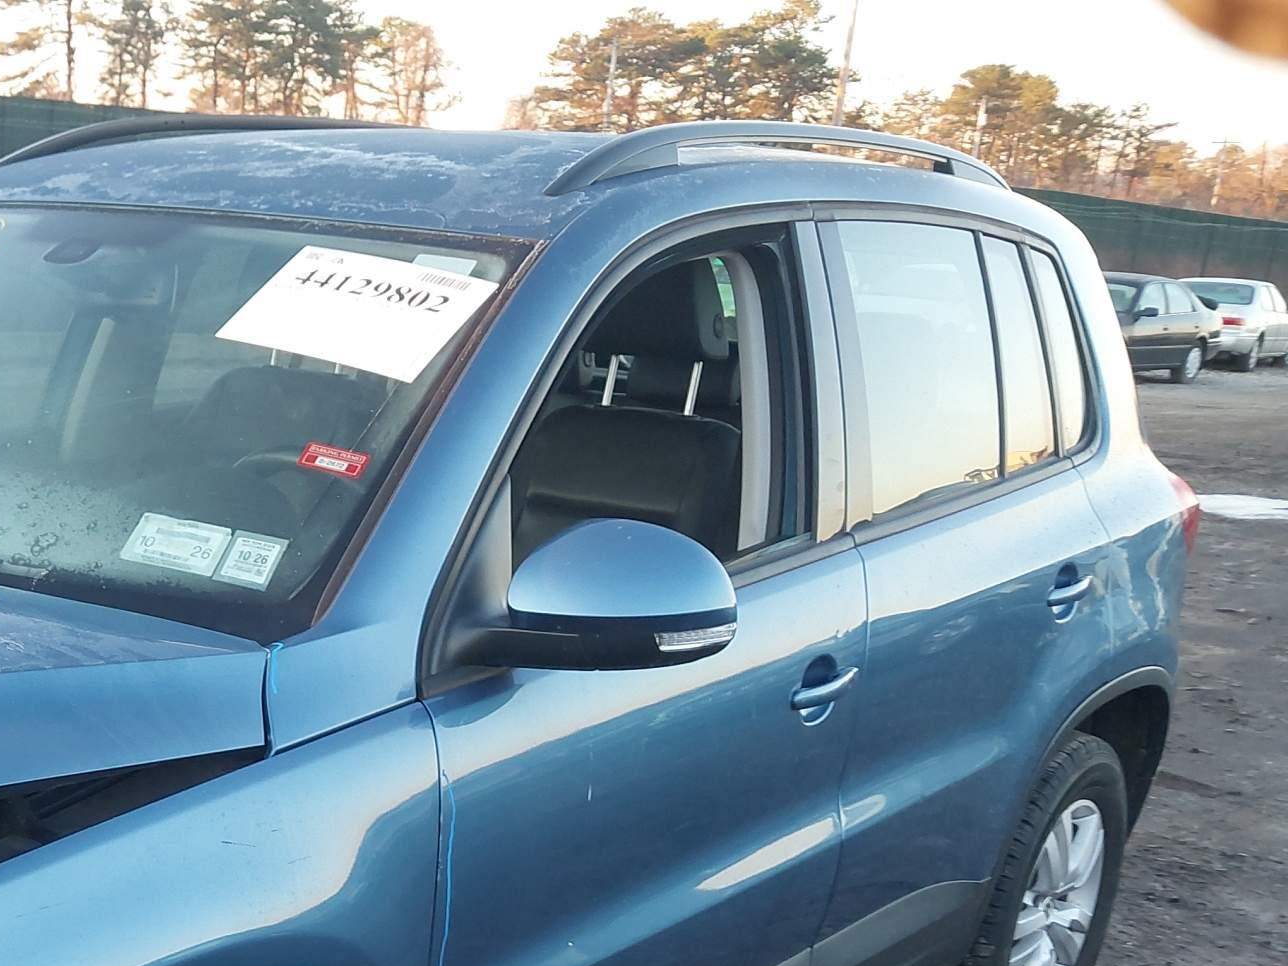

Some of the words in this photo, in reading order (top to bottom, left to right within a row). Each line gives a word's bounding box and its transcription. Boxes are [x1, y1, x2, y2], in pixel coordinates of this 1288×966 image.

[295, 269, 450, 312] 44129802
[139, 535, 156, 548] 10
[190, 545, 213, 561] 26
[238, 550, 251, 561] 10
[253, 553, 270, 565] 26
